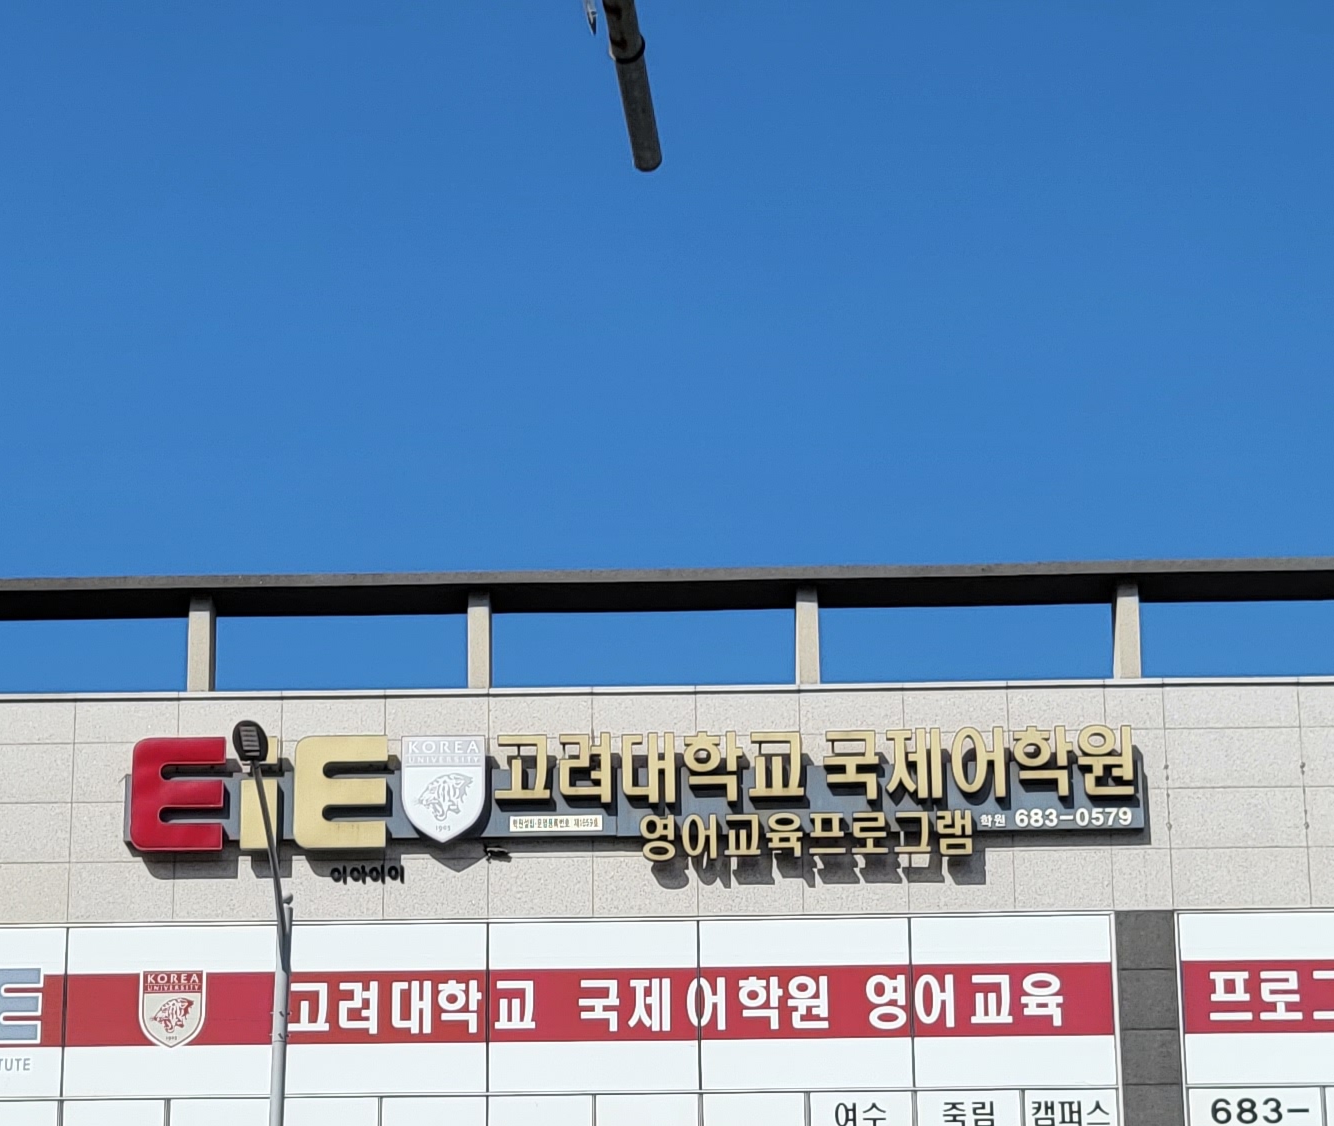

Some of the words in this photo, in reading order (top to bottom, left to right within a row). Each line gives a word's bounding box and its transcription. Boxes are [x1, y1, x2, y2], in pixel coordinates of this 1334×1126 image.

[407, 741, 479, 755] KOREA
[407, 754, 480, 764] UNIVERSITY
[494, 731, 805, 803] 고려대학교
[821, 725, 1139, 800] 국제어학원
[980, 812, 1007, 828] 학원
[1014, 807, 1133, 827] 683-0579
[146, 972, 200, 984] KOREA
[146, 983, 201, 991] UNIVERSITY
[291, 980, 537, 1036] 고려대학교
[578, 977, 831, 1034] 국제어학원
[865, 973, 1065, 1030] 영어교육
[1031, 1098, 1112, 1126] 캠퍼스
